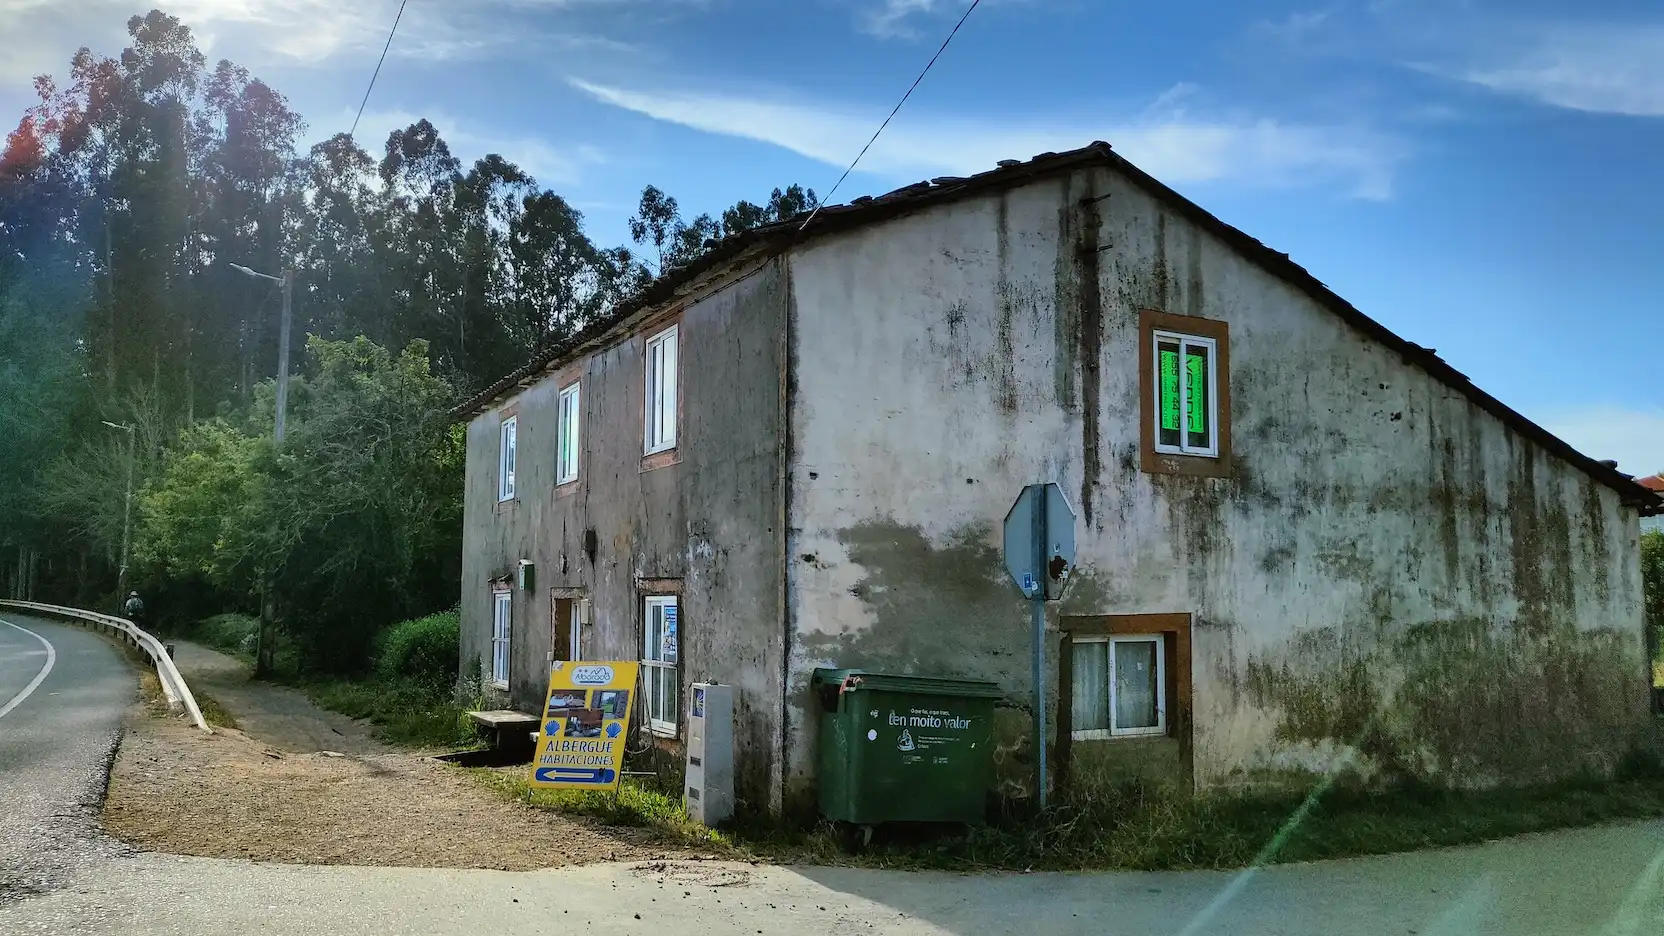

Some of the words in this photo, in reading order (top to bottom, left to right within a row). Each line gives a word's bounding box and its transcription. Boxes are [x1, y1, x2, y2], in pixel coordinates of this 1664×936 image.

[1171, 380, 1180, 393] 75
[1172, 397, 1180, 411] 44
[888, 711, 907, 727] ten
[909, 715, 942, 728] moito
[943, 715, 972, 729] valor
[546, 740, 614, 753] ALBERGUE
[540, 754, 615, 766] HABITACIONES
